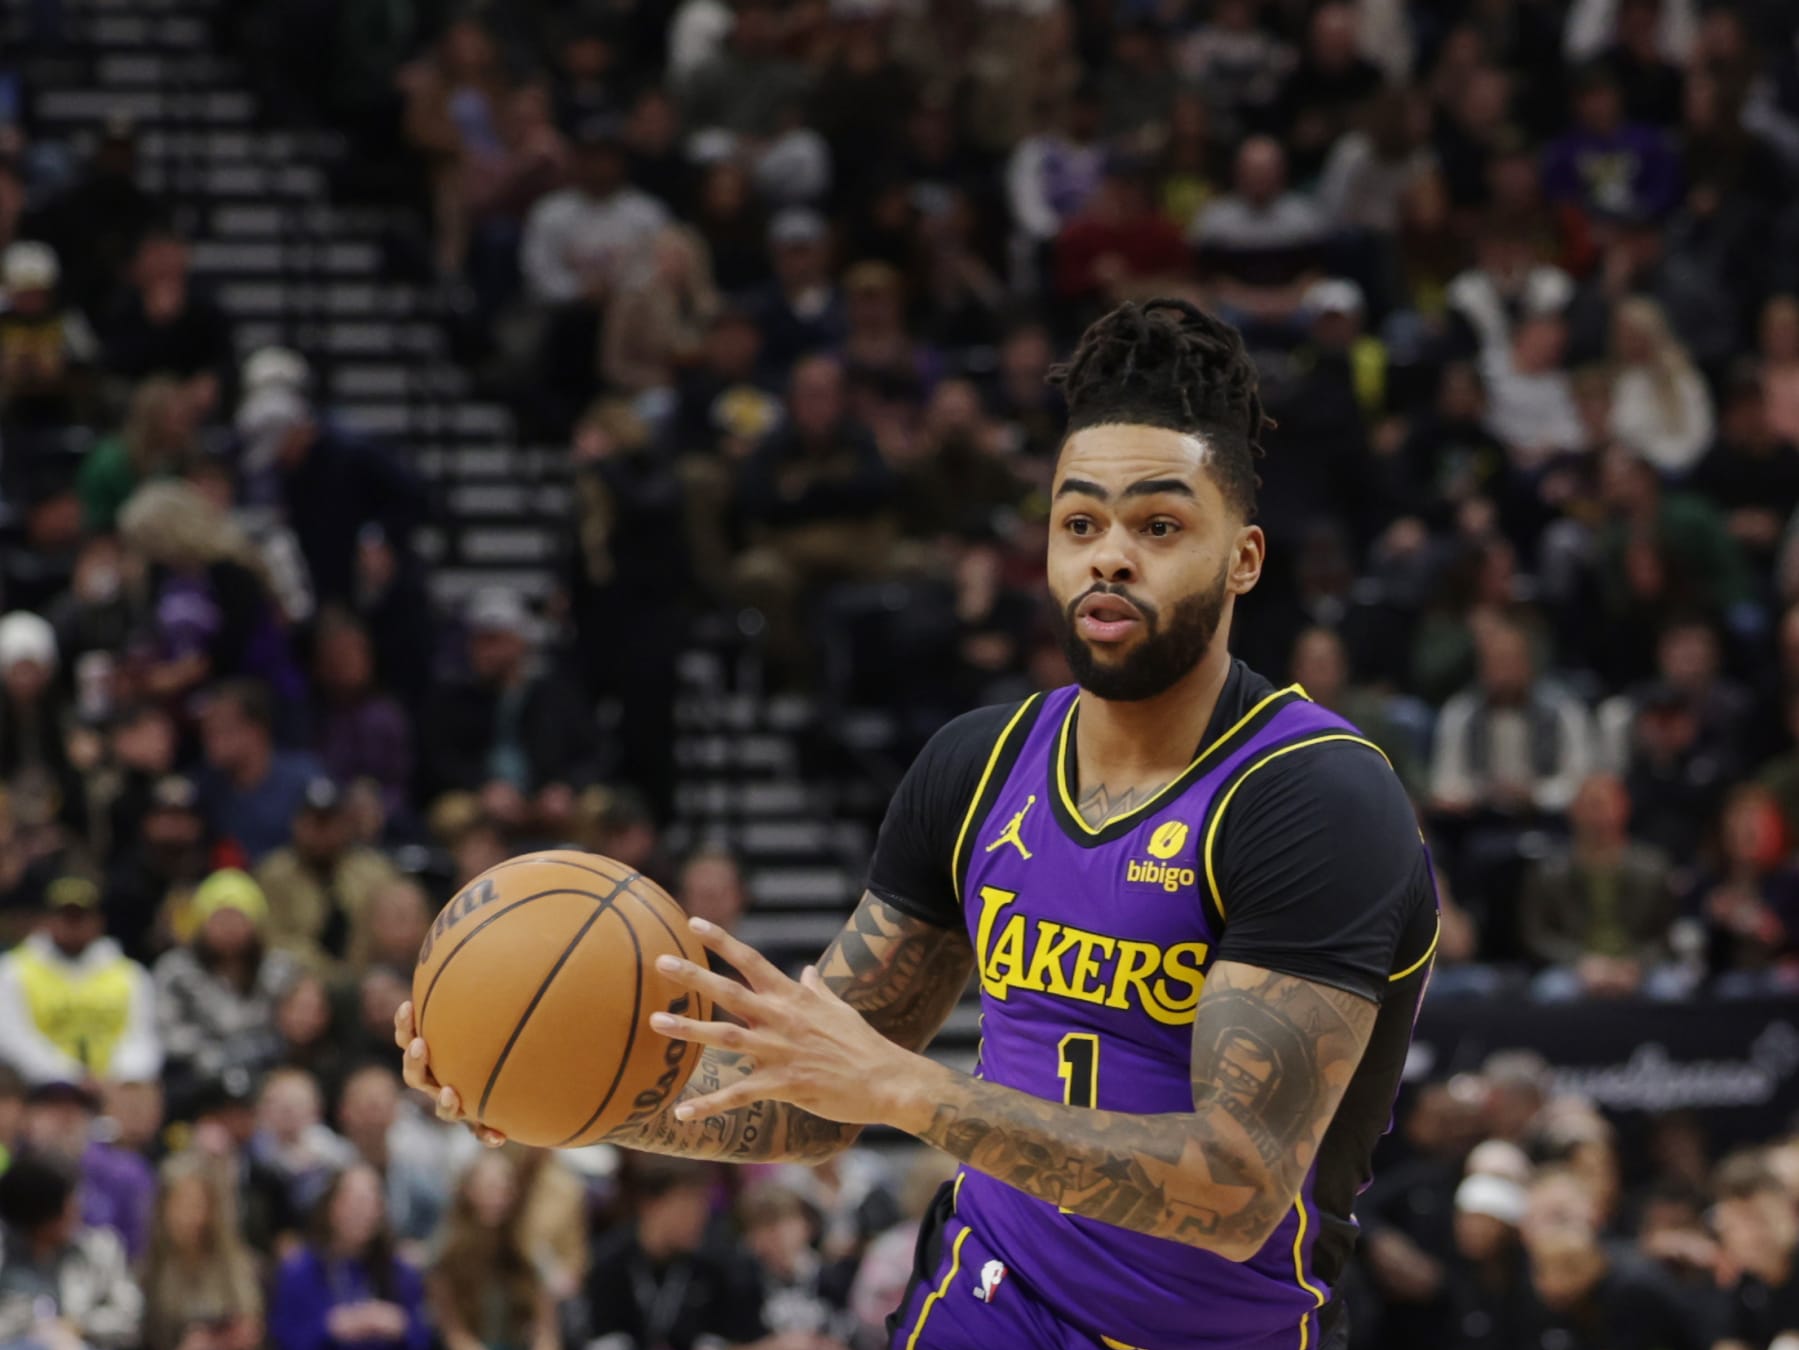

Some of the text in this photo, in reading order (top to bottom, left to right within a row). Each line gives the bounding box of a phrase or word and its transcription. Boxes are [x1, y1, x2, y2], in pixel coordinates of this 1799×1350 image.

[1126, 859, 1196, 893] bibigo
[976, 884, 1210, 1027] LAKERS
[1057, 1031, 1100, 1111] 1
